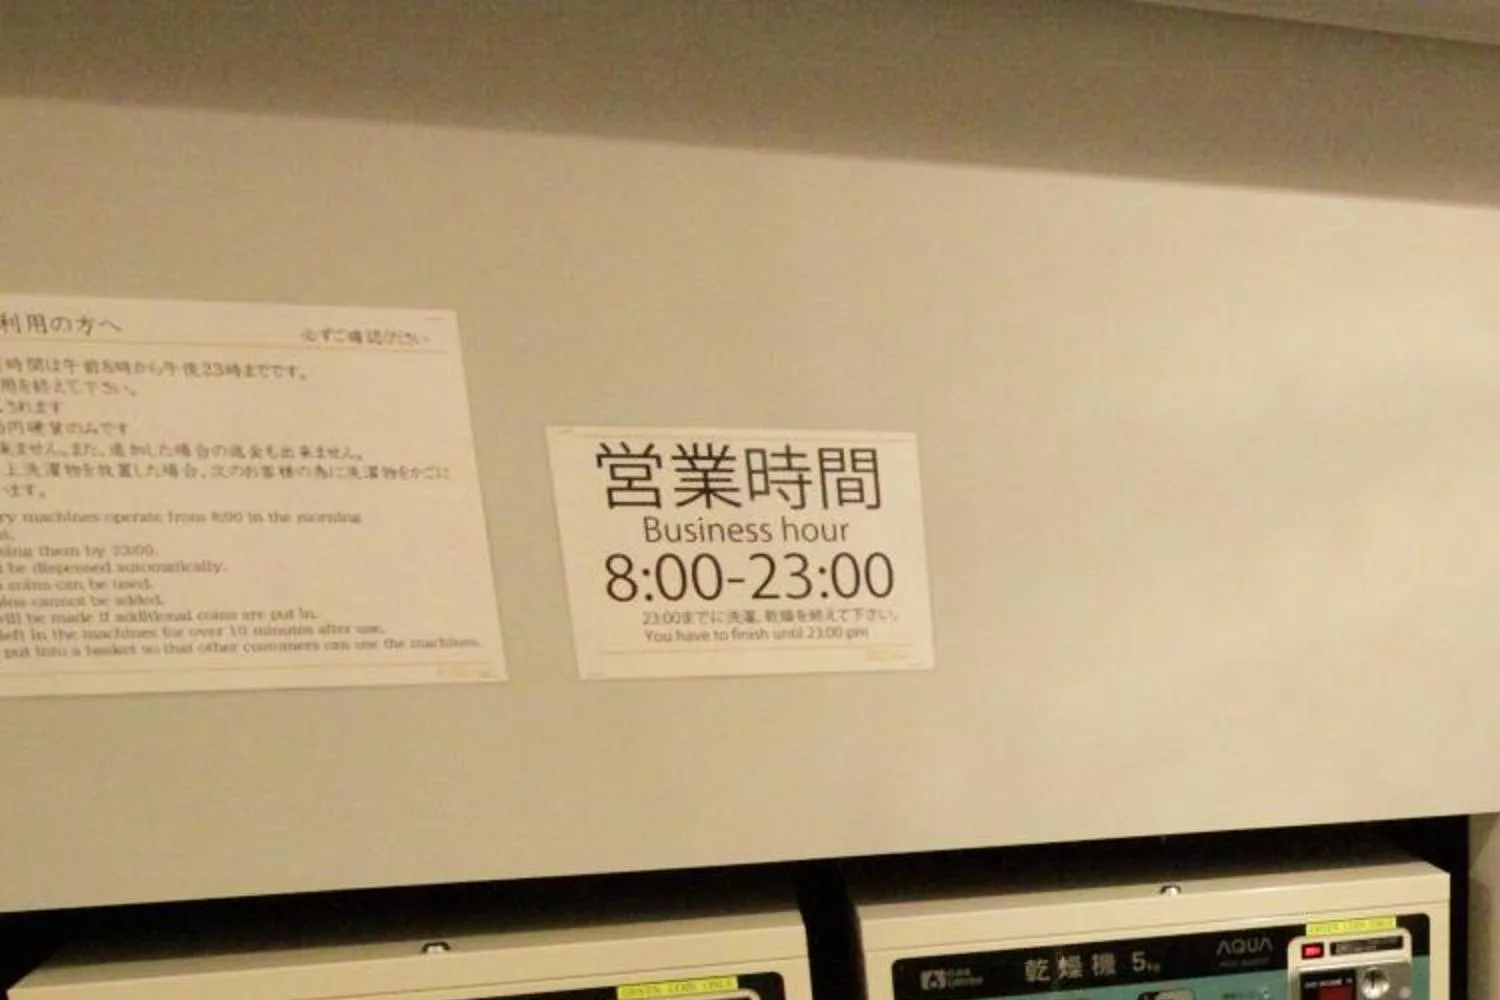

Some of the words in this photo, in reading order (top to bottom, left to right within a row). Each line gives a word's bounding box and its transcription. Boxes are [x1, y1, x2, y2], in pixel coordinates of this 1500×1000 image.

[596, 441, 882, 511] 営業時間
[22, 511, 100, 523] machines
[168, 511, 206, 523] from
[249, 511, 263, 523] in
[268, 511, 290, 523] the
[297, 511, 362, 525] morning
[642, 515, 773, 545] Business
[781, 516, 850, 543] hour
[39, 545, 79, 557] them
[84, 544, 105, 559] by
[7, 561, 26, 573] be
[56, 580, 83, 590] can
[89, 577, 107, 589] be
[604, 551, 895, 602] 8:00-23:00
[91, 594, 109, 606] be
[26, 611, 45, 624] be
[51, 610, 93, 623] made
[242, 609, 266, 621] are
[270, 608, 293, 622] put
[30, 628, 47, 641] in
[52, 628, 76, 640] the
[82, 627, 158, 640] machines
[162, 626, 184, 639] for
[189, 627, 223, 638] over
[644, 629, 672, 643] You
[676, 628, 710, 642] have
[713, 629, 728, 642] to
[731, 627, 768, 641] finish
[773, 626, 803, 640] until
[3, 645, 30, 660] put
[35, 644, 67, 657] into
[71, 647, 81, 657] a
[163, 643, 192, 655] that
[197, 642, 238, 655] other
[324, 641, 350, 652] can
[354, 640, 378, 651] use
[383, 637, 405, 649] the
[1216, 936, 1274, 957] AQUA
